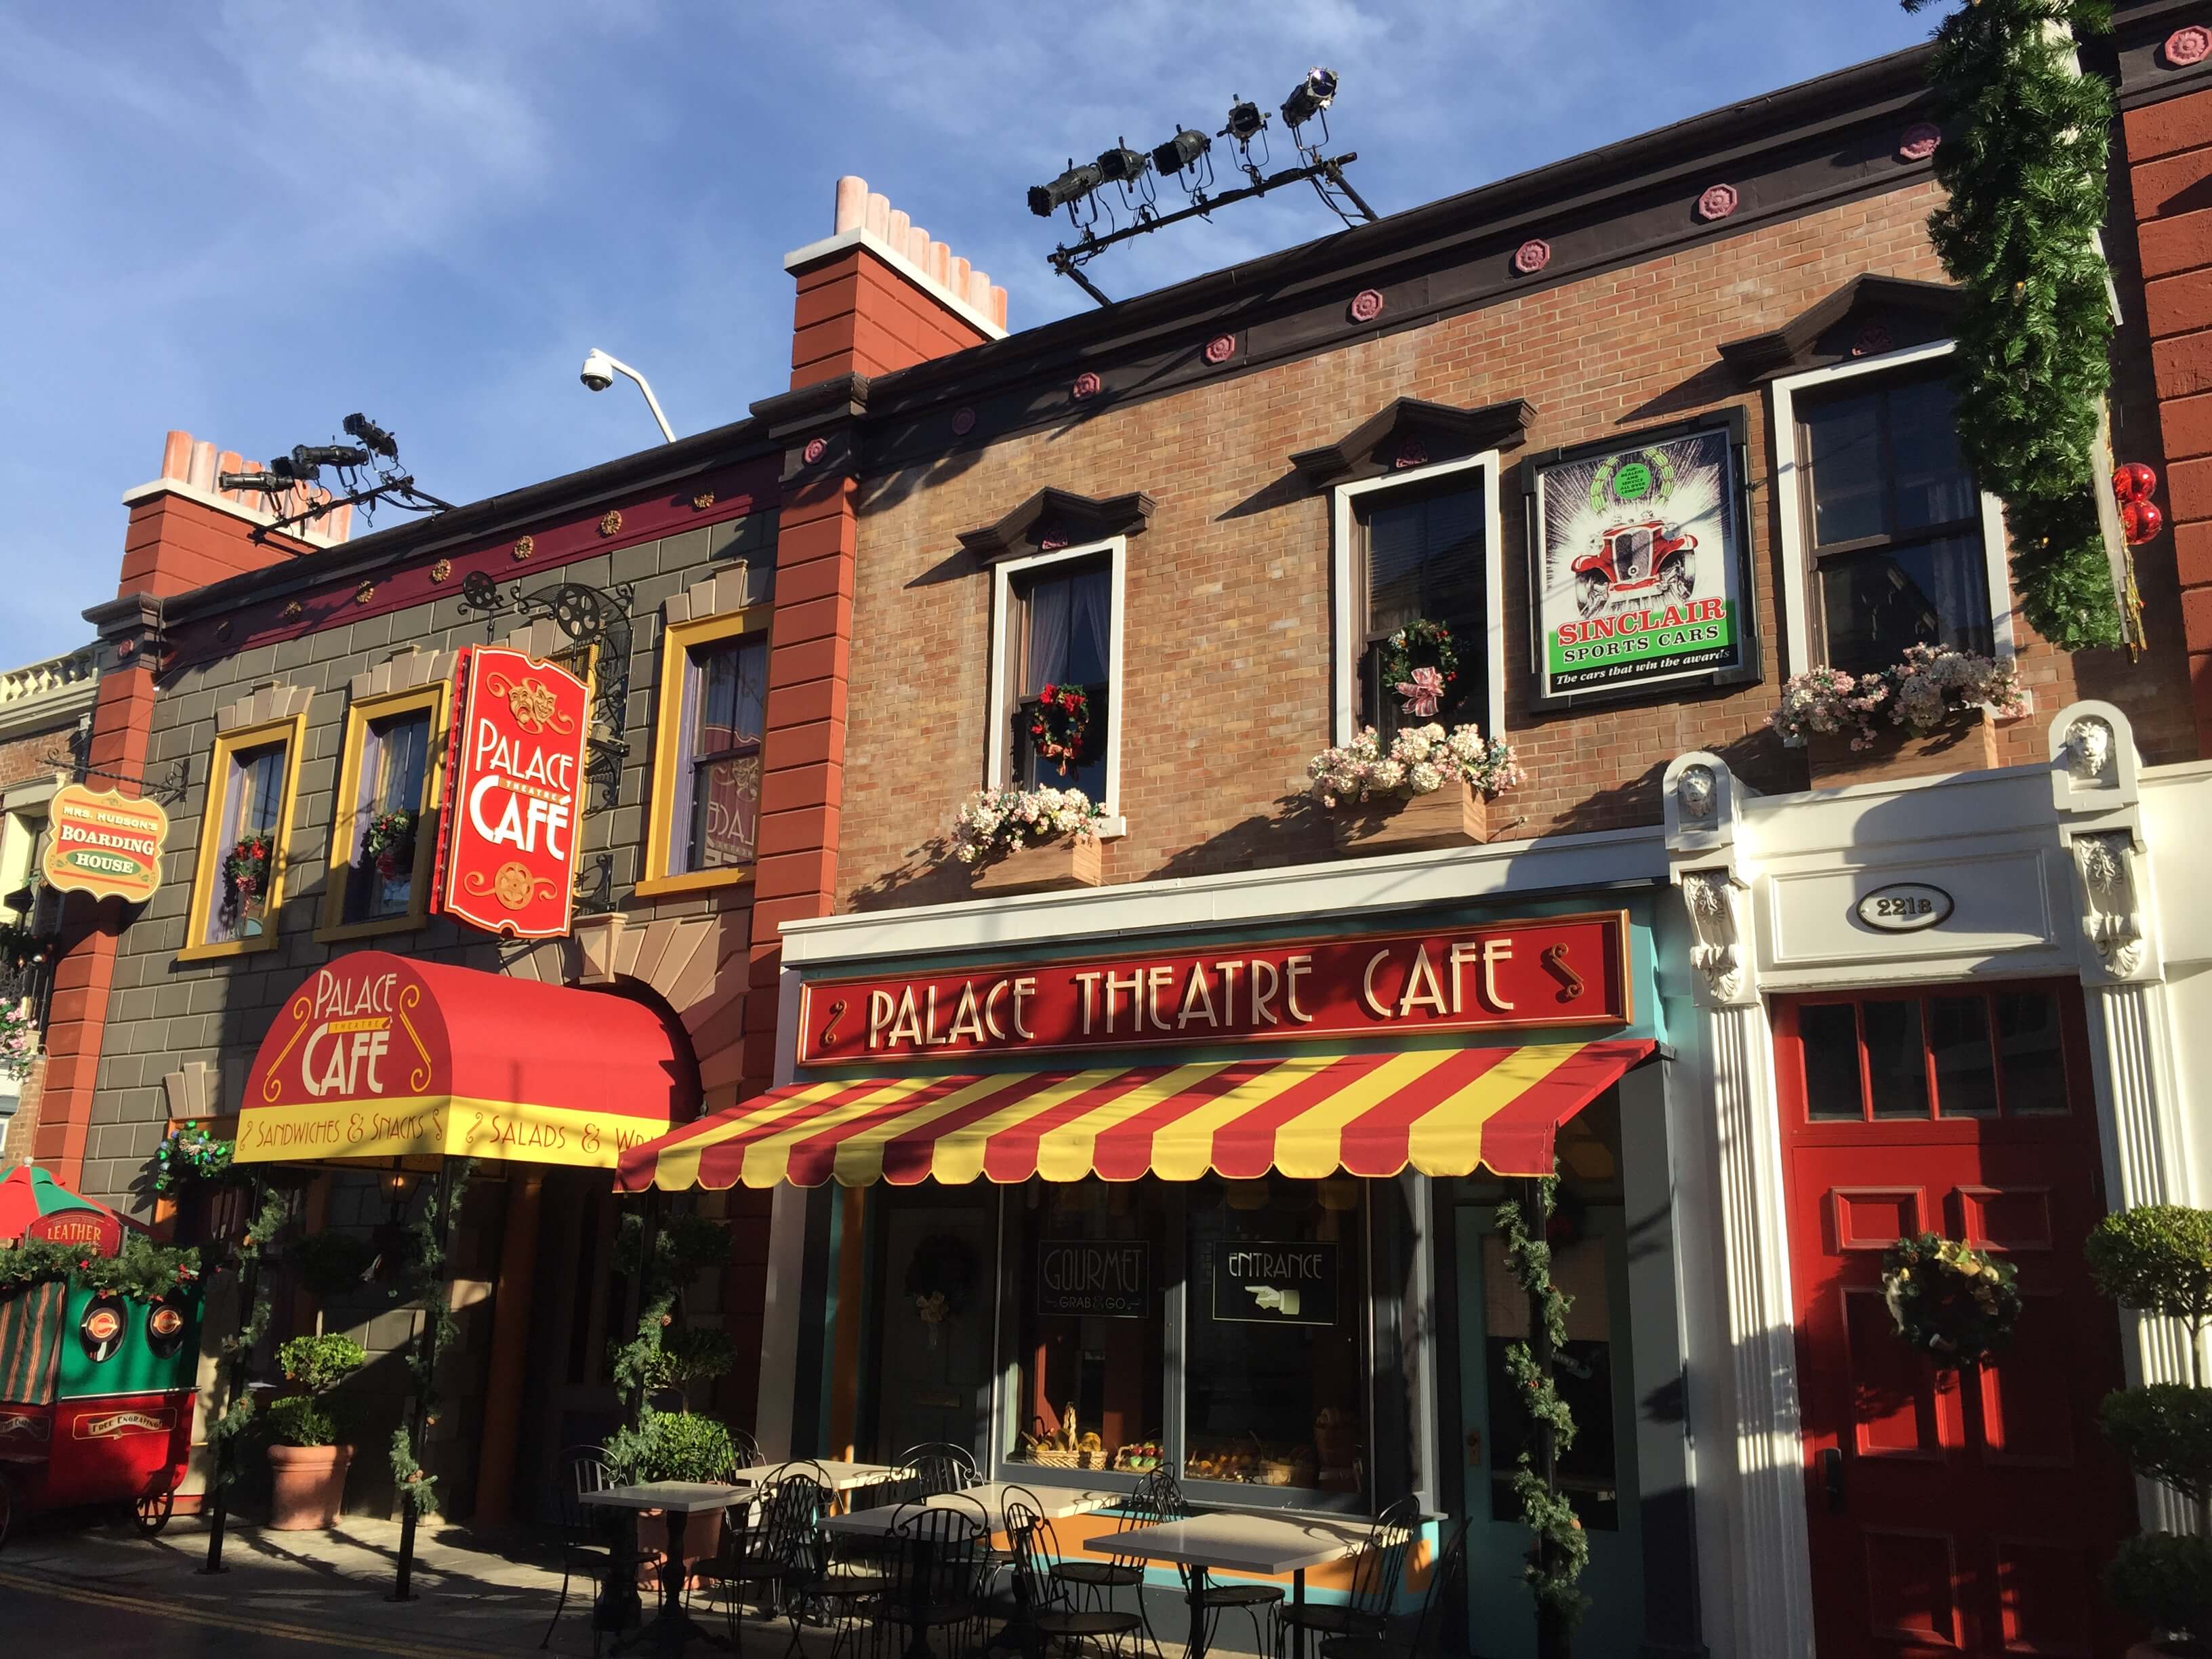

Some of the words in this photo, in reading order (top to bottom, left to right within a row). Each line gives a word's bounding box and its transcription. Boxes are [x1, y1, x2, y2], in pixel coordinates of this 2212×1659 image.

[1557, 597, 1726, 647] SINCLAIR
[1564, 637, 1649, 663] SPORTS
[1658, 625, 1719, 647] CARS
[1556, 674, 1578, 685] The
[1578, 670, 1605, 682] cars
[1608, 663, 1633, 677] that
[1635, 659, 1657, 672] win
[1660, 656, 1680, 669] the
[1682, 649, 1730, 665] awards
[475, 718, 574, 792] PALACE
[506, 779, 558, 802] THEATRE
[63, 806, 94, 819] MRS.
[96, 813, 158, 832] HUDSON'S
[469, 775, 572, 861] CAFÉ
[60, 825, 155, 856] BOARDING
[75, 853, 134, 874] HOUSE
[1877, 897, 1932, 917] 221B
[314, 970, 397, 1019] PALACE
[869, 977, 1036, 1048] PALACE
[1076, 955, 1313, 1035] THEATRE
[334, 1019, 380, 1031] THEATRE
[255, 1119, 341, 1148] SANDWICHES
[347, 1113, 364, 1144] &
[370, 1113, 424, 1141] SNACKS
[489, 1115, 565, 1149] SALADS
[581, 1122, 600, 1154] &
[47, 1223, 102, 1241] LEATHER
[1044, 1248, 1143, 1292] GOURMET
[1228, 1252, 1322, 1279] ENTRANCE
[1059, 1296, 1092, 1309] GRAB
[1105, 1297, 1126, 1309] GO
[92, 1420, 113, 1433] FREE
